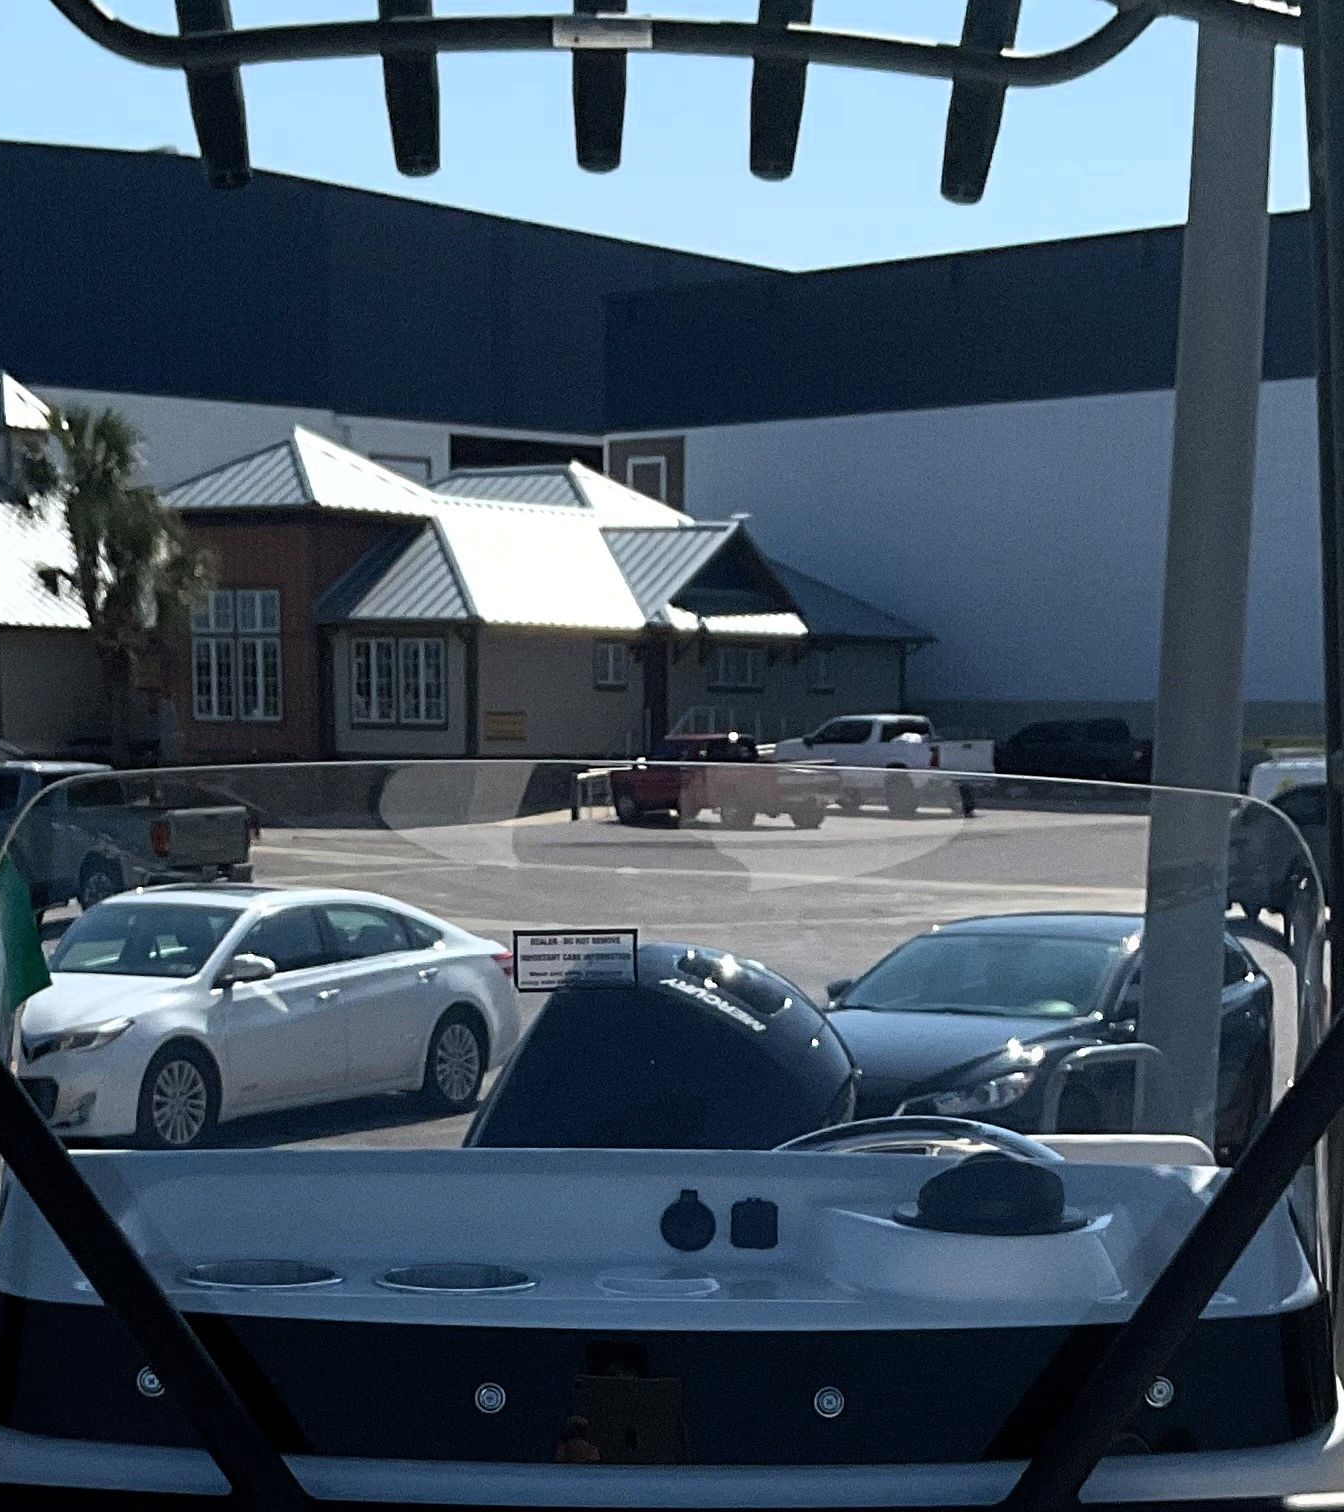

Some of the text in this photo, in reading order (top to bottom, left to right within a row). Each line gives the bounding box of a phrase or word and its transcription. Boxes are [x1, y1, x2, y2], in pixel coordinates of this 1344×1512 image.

[563, 937, 574, 945] DO
[575, 937, 590, 945] NOT
[592, 936, 621, 945] REMOVE
[520, 953, 560, 962] IMPORTANT
[562, 953, 581, 961] CARE
[659, 978, 767, 1032] MERCURY
